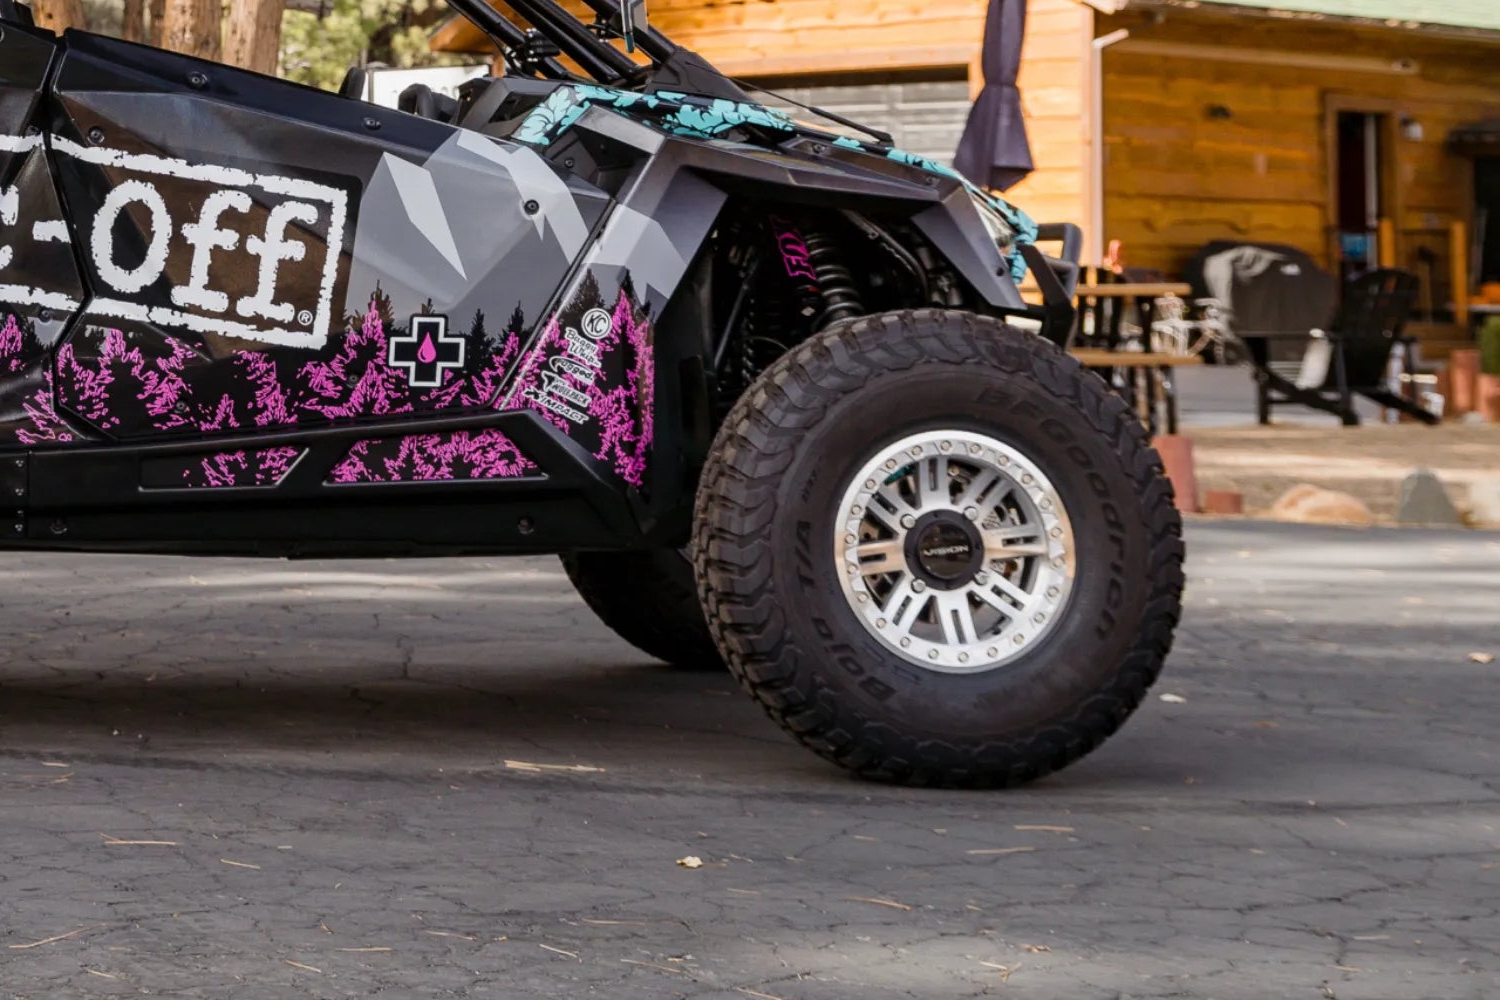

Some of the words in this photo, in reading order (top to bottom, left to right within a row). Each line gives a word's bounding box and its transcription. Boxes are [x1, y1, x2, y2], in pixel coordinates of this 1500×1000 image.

[586, 314, 607, 334] KC
[976, 384, 1125, 640] BFGoodrich
[795, 520, 815, 592] T/A
[811, 617, 897, 701] Baja
